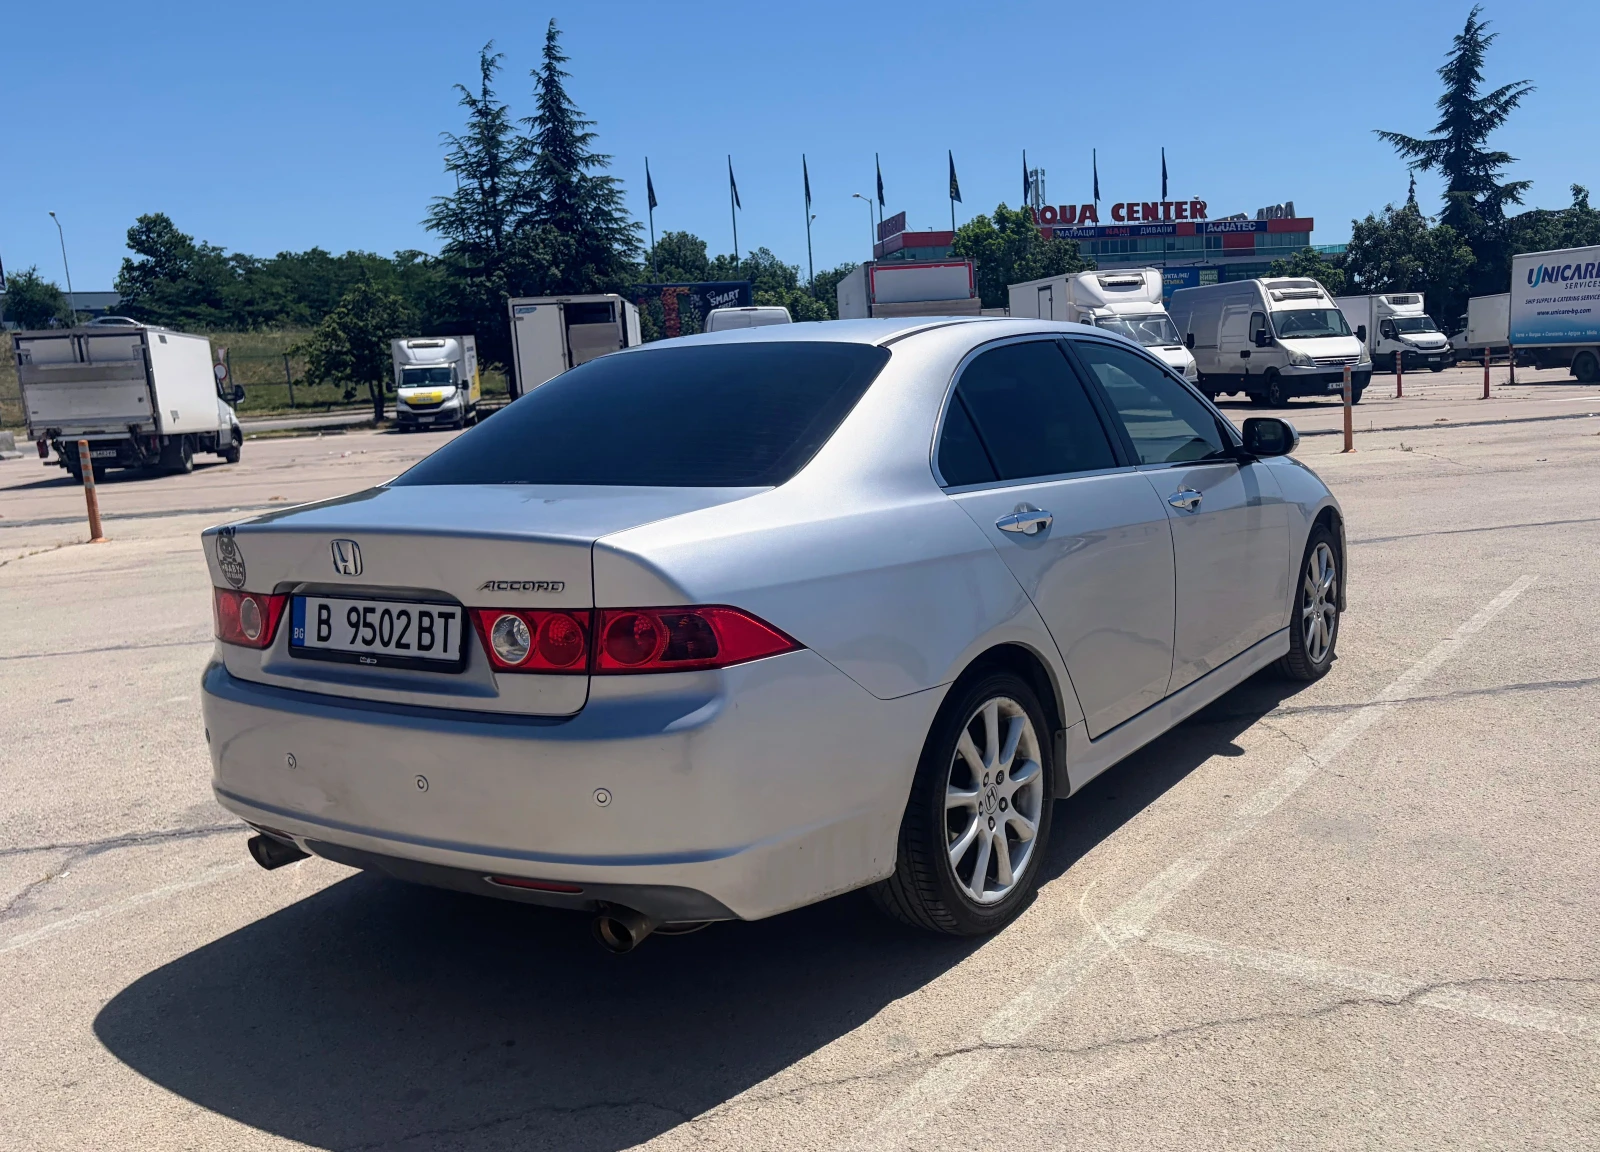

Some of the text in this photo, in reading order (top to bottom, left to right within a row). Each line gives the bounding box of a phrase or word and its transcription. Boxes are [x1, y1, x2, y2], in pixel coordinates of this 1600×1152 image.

[1111, 200, 1207, 222] CENTER
[1207, 221, 1256, 232] AQUATEC
[710, 289, 740, 306] SMART
[477, 581, 565, 593] ACCORD
[317, 603, 332, 642] B
[294, 627, 304, 639] BG
